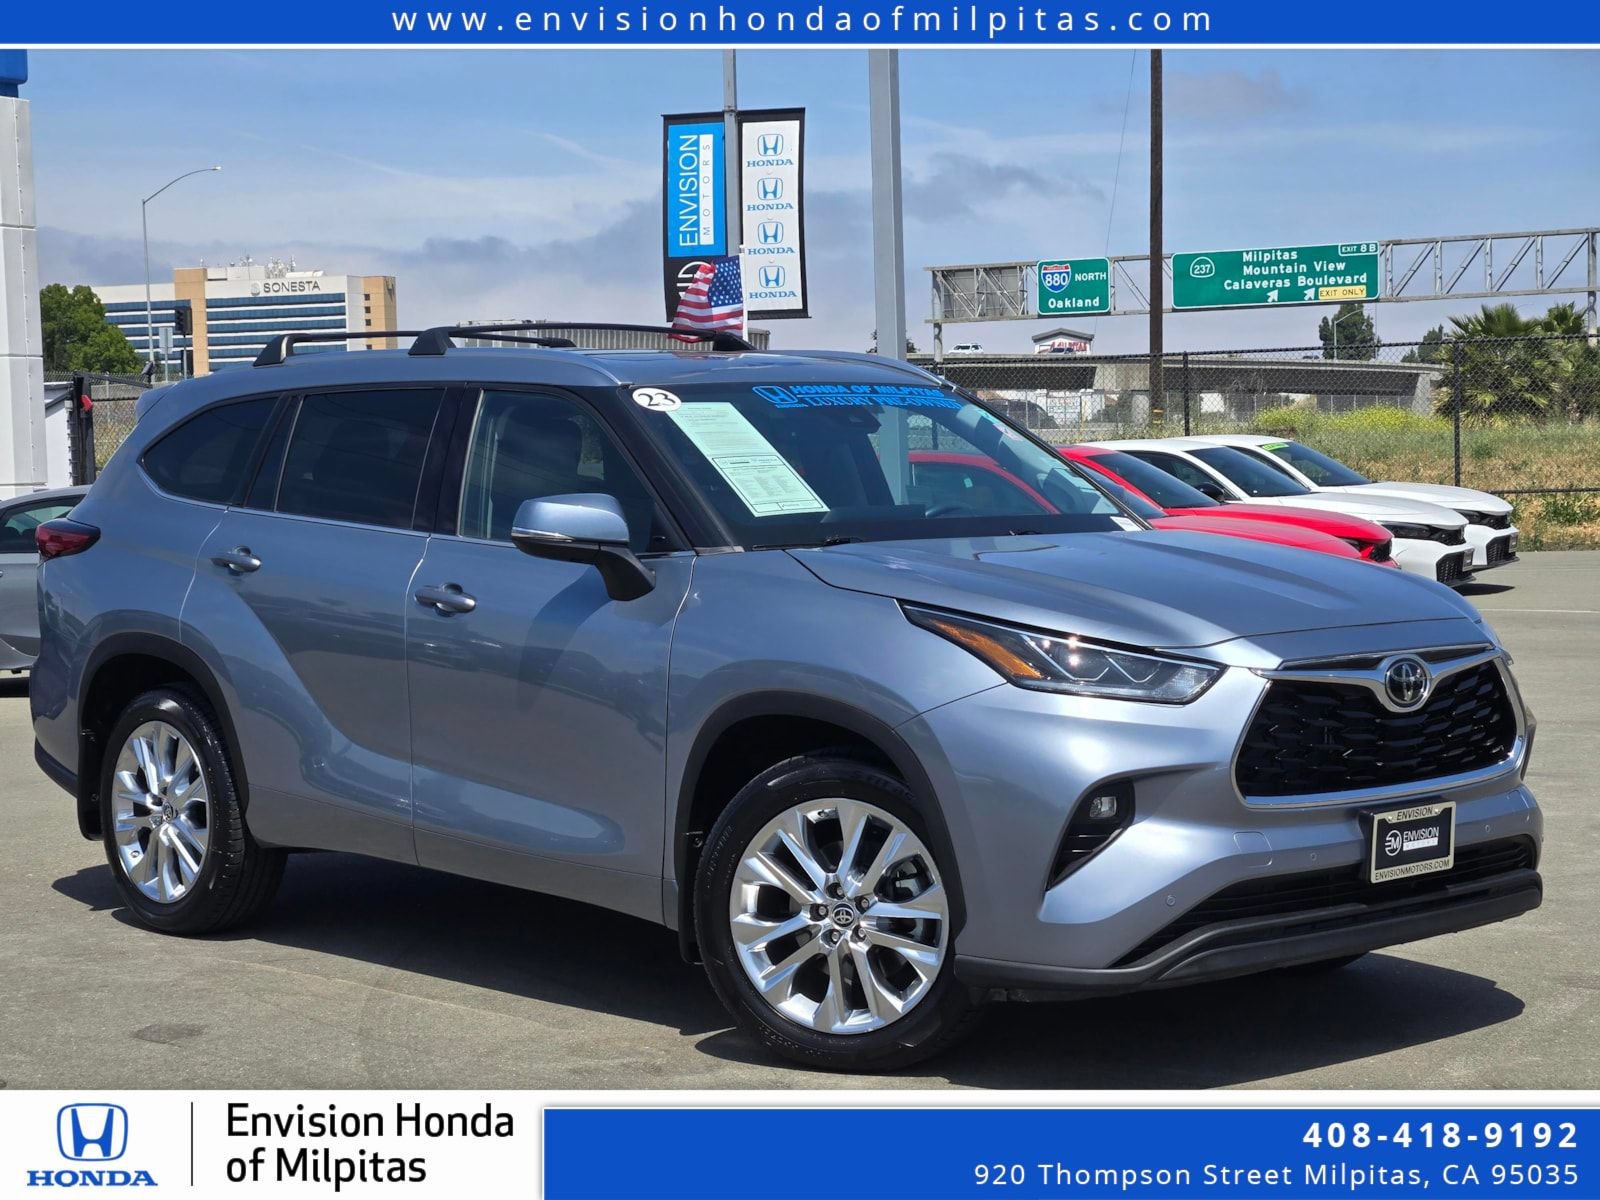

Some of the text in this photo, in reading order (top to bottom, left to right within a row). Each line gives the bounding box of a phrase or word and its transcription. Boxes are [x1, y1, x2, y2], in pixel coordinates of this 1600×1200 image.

[746, 158, 794, 168] HONDA
[679, 134, 698, 247] ENVISION
[702, 143, 711, 236] MOTORS
[746, 202, 794, 211] HONDA
[747, 246, 795, 255] HONDA
[1342, 245, 1357, 253] EXIT
[1242, 250, 1298, 264] Milpitas
[1193, 263, 1212, 274] 237
[1243, 261, 1346, 276] Mountain View
[1045, 272, 1107, 286] 880 NORTH
[1224, 272, 1367, 291] Calaveras Boulevard
[263, 280, 320, 293] SONESTA
[1342, 288, 1365, 296] ONLY
[749, 290, 797, 299] HONDA
[1048, 296, 1100, 309] Oakland
[788, 384, 851, 394] HONDA
[637, 392, 676, 407] 23
[1396, 806, 1434, 821] ENVISION
[1403, 826, 1440, 843] ENVISION
[1375, 859, 1450, 881] ENVISIONMOTORS.COM
